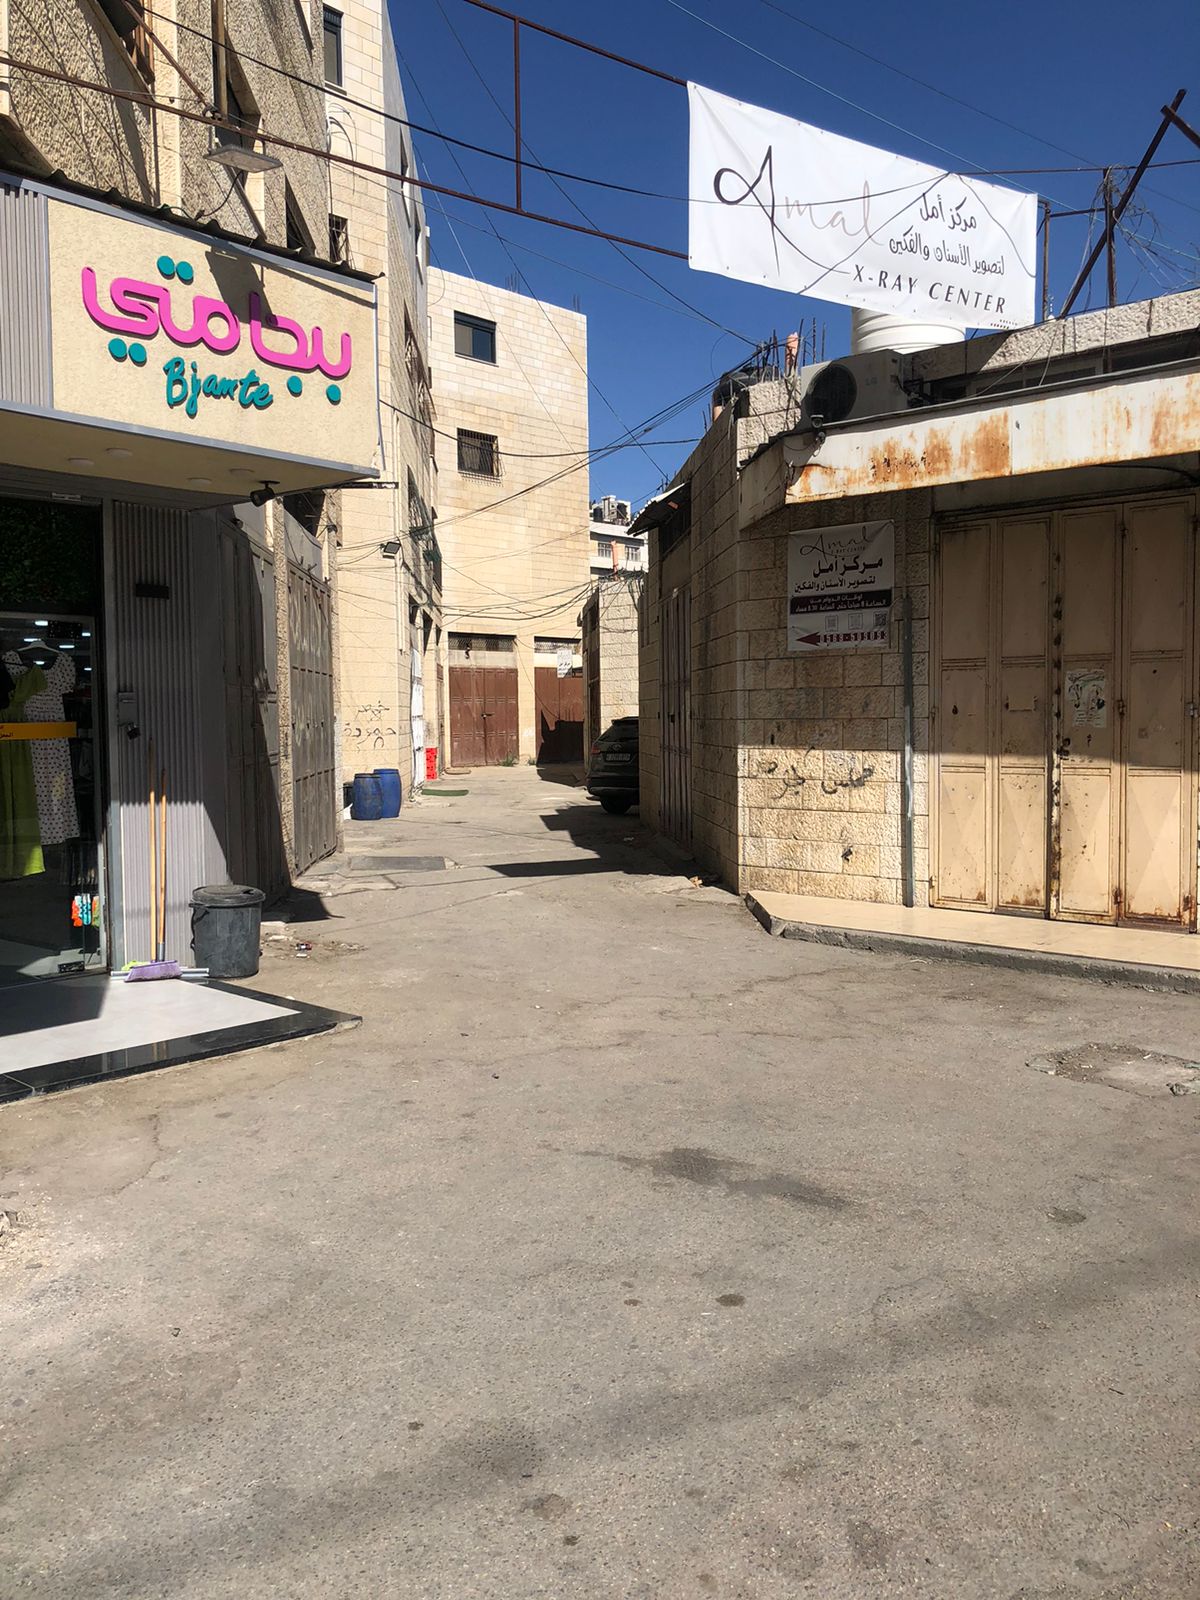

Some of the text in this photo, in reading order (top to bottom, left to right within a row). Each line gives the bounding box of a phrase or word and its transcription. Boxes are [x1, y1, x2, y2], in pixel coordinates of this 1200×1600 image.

[713, 144, 885, 277] Amal
[919, 192, 978, 233] مركز أمل
[888, 225, 1006, 276] لتصوير الأسنان والفكين
[852, 263, 1008, 314] X-RAY CENTER
[82, 255, 353, 405] بجامتي
[163, 356, 273, 418] Bjamte
[793, 574, 876, 594] لتصوير الأسنان والفكين
[812, 554, 884, 578] مركز أمل
